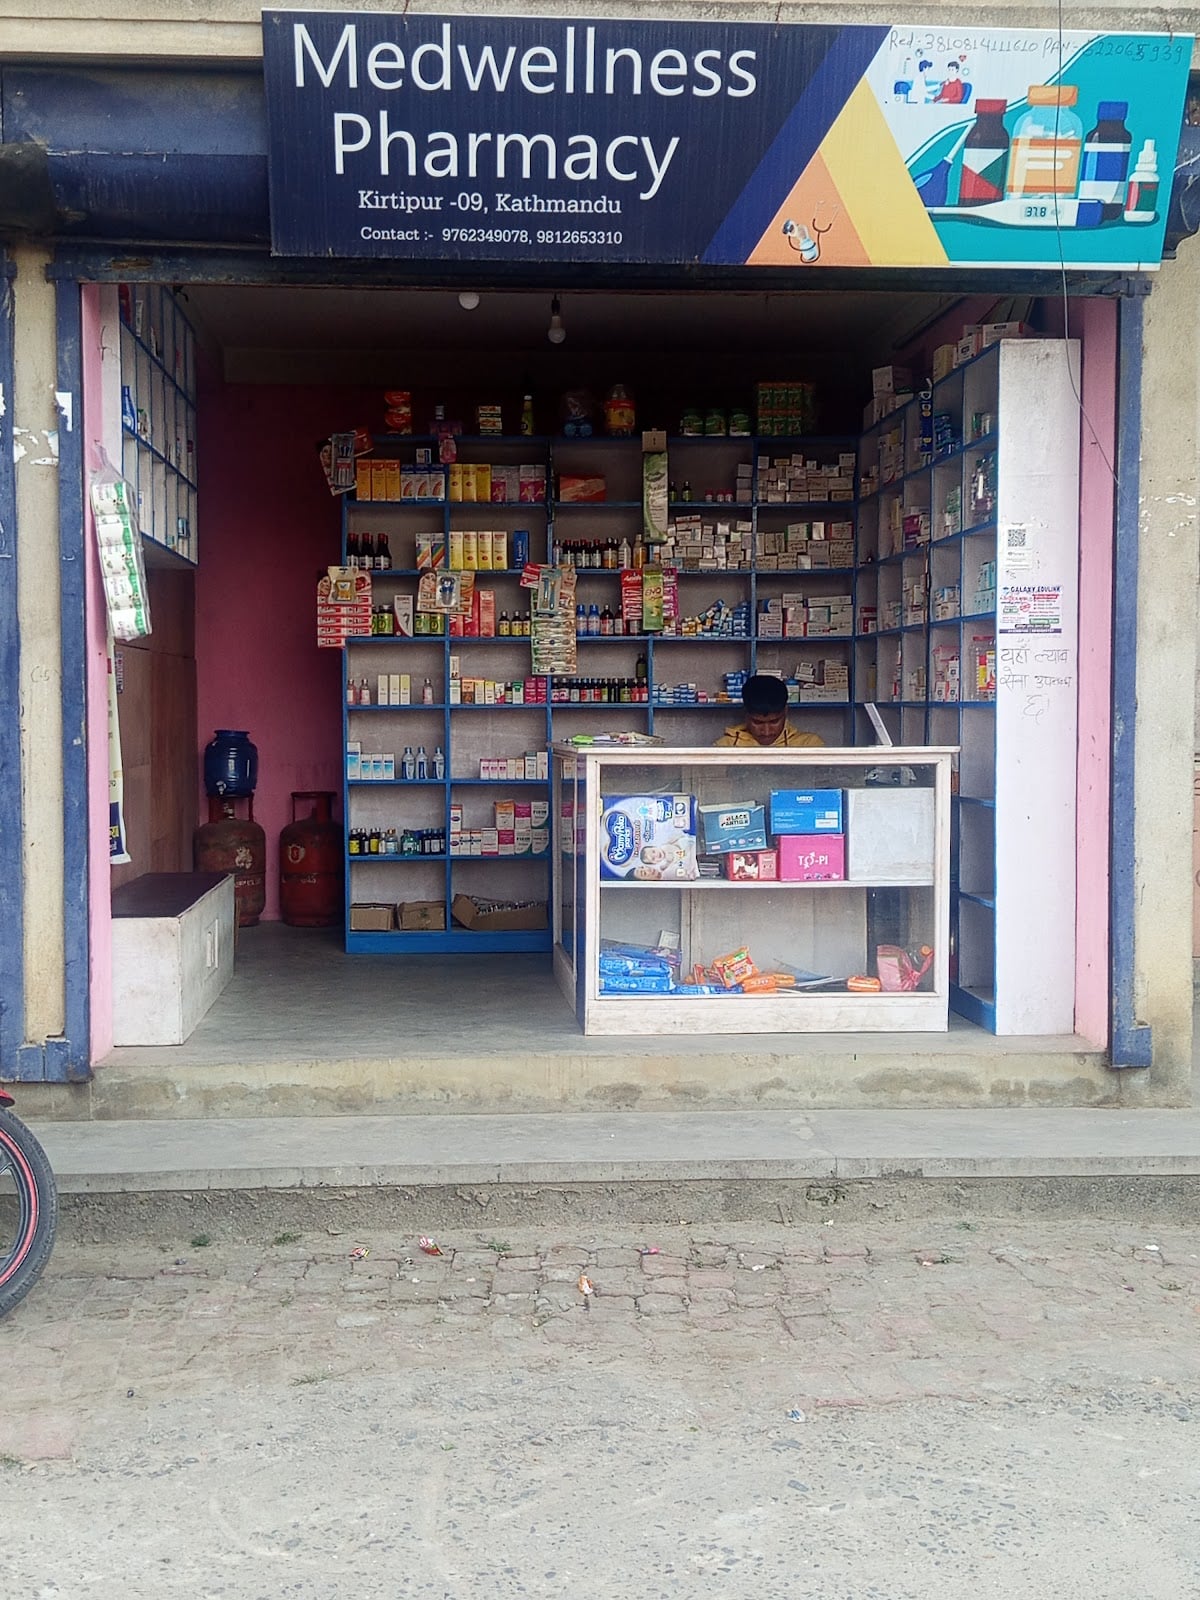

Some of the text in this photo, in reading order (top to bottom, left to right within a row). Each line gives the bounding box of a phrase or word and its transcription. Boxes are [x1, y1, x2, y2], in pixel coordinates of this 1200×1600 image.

[292, 23, 758, 98] Medwellness
[333, 110, 680, 200] Pharmacy
[358, 190, 444, 213] Kirtipur
[495, 193, 622, 214] Kathmandu
[360, 227, 420, 241] Contact
[442, 228, 532, 245] 9762349078,
[536, 230, 623, 245] 9812653310
